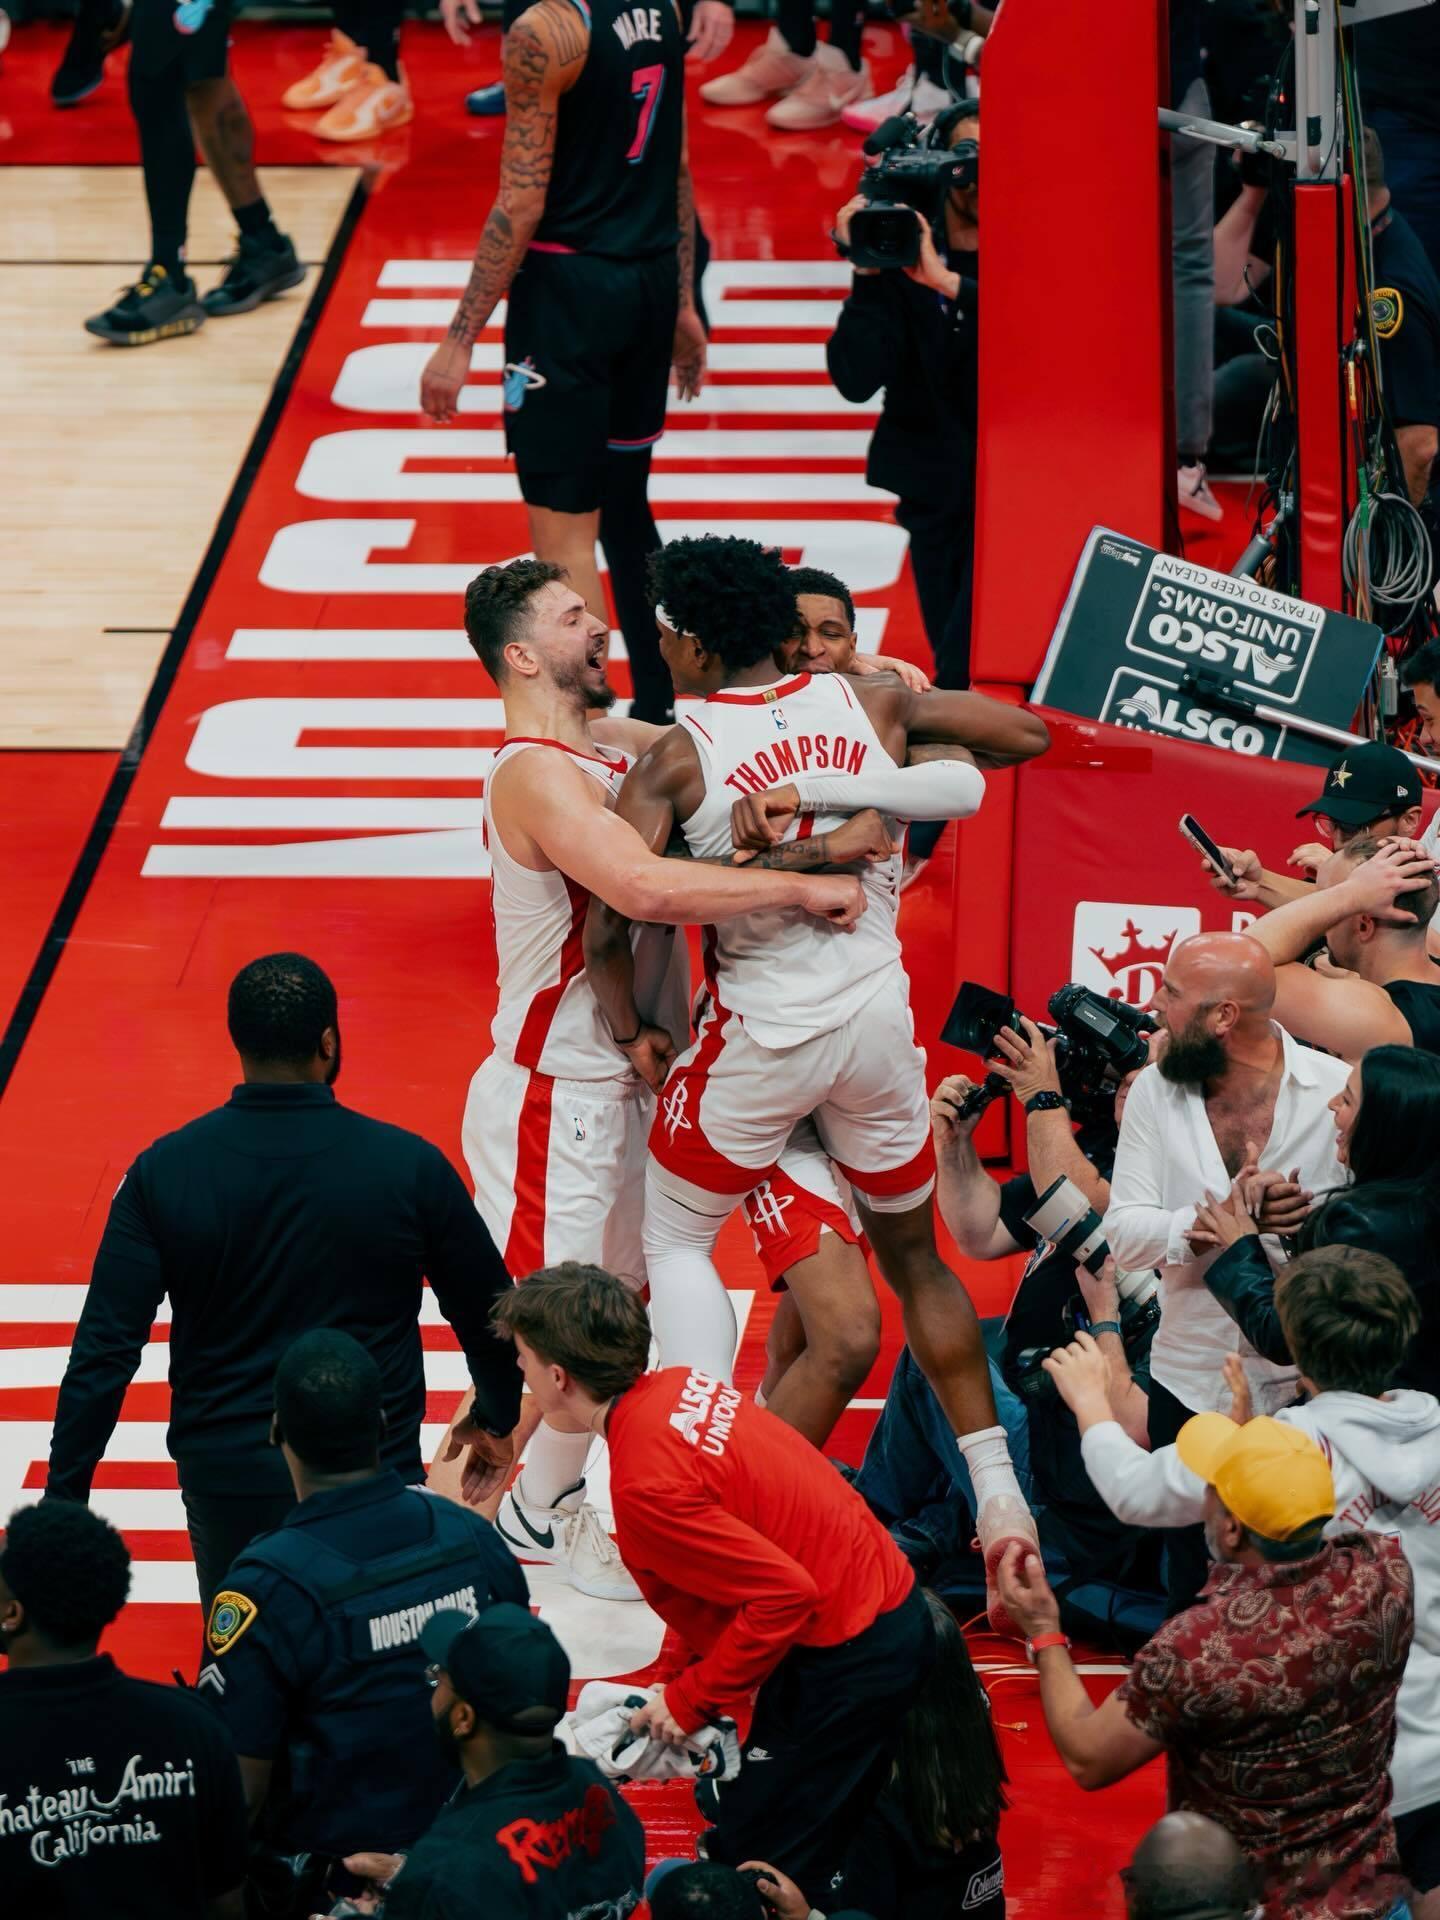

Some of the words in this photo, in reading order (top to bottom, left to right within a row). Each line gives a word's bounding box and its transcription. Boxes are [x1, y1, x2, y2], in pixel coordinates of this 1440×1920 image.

[612, 8, 663, 51] WARE
[624, 63, 667, 165] 7
[1211, 579, 1245, 598] KEEP
[1249, 591, 1269, 606] TO
[1270, 602, 1306, 619] PAYS
[1309, 608, 1322, 624] IT
[1149, 612, 1298, 686] ALSCO
[1115, 685, 1265, 756] ALSCO
[724, 734, 868, 796] THOMPSON
[64, 1757, 96, 1776] THE
[0, 1785, 89, 1837] hateau
[90, 1754, 196, 1809] Amiri
[30, 1813, 162, 1867] California
